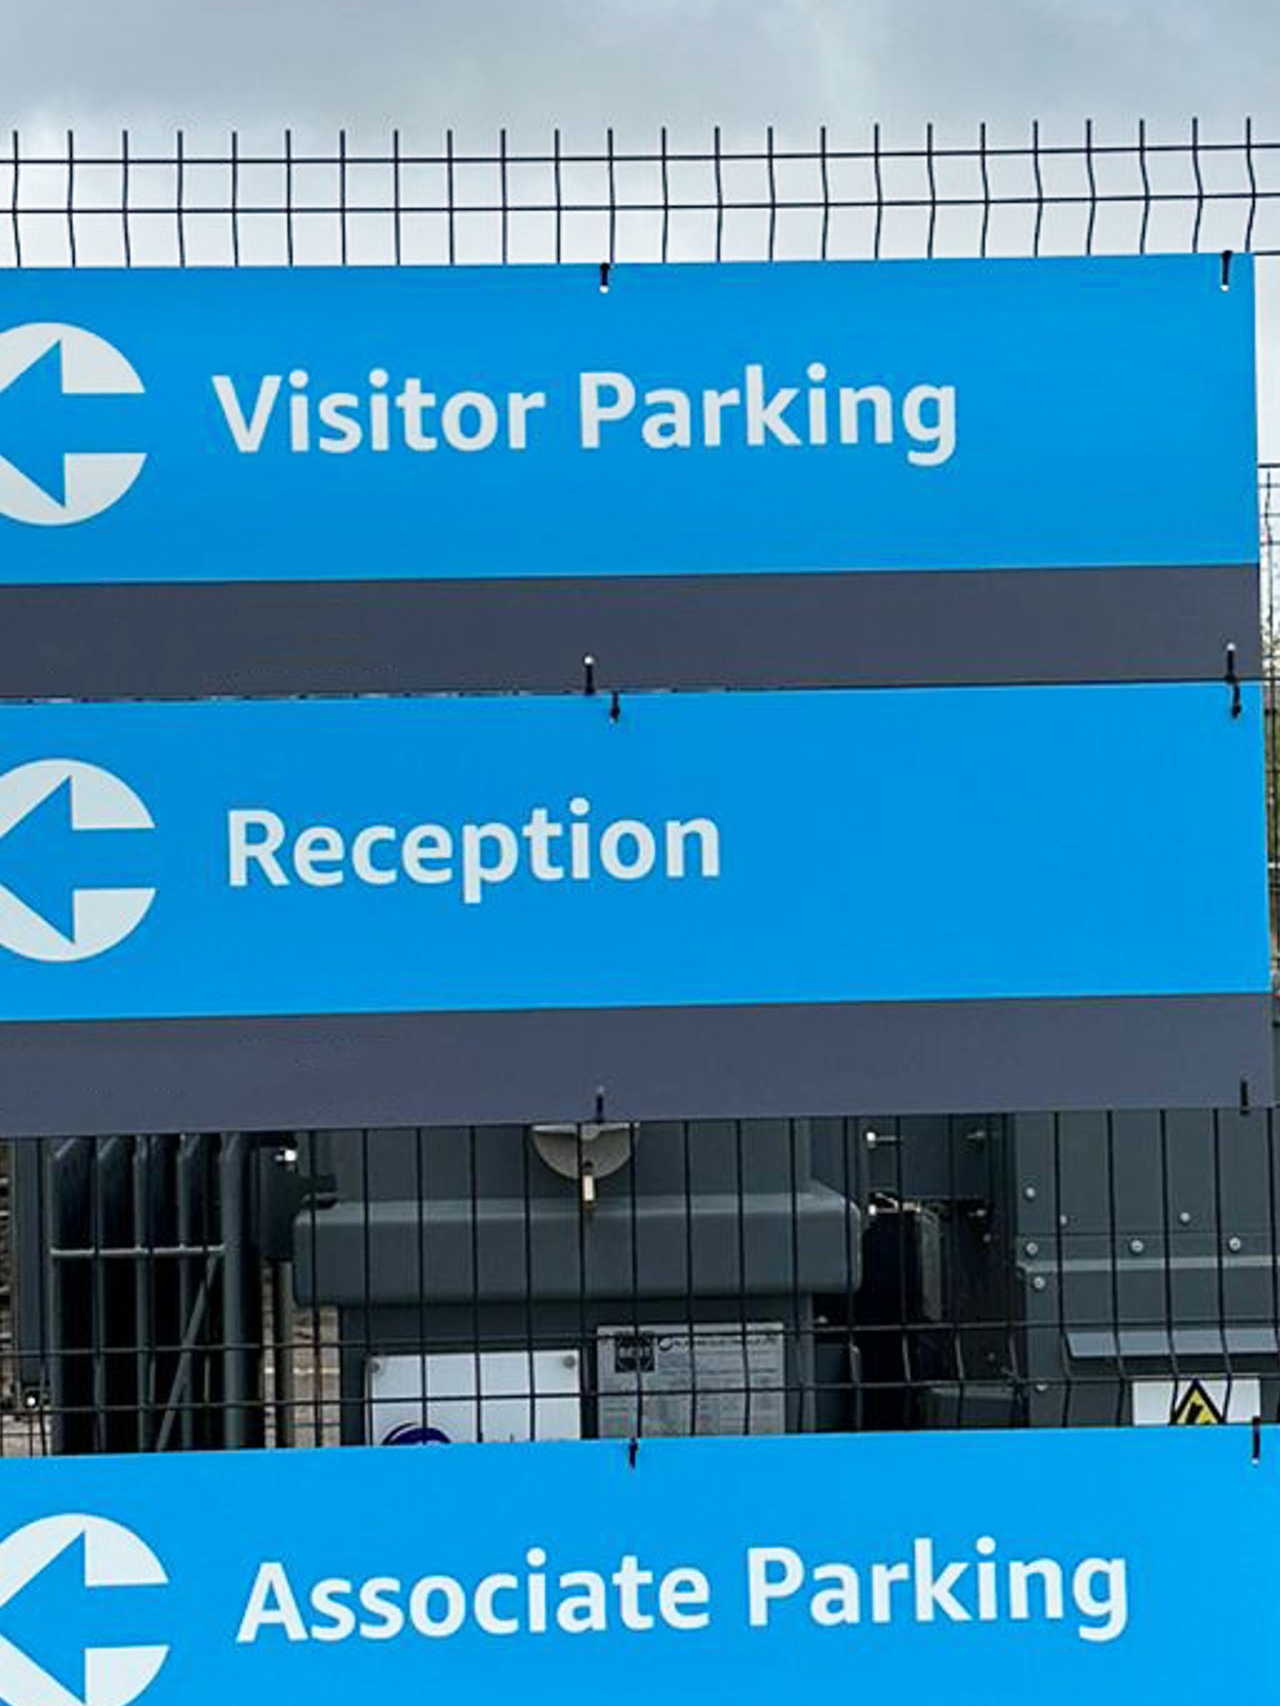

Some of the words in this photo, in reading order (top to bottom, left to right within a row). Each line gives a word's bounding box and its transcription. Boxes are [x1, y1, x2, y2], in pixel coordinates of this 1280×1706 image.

[213, 370, 546, 453] Visitor
[580, 362, 956, 466] Parking
[229, 798, 719, 904] Reception
[237, 1548, 710, 1642] Associate
[748, 1536, 1127, 1642] Parking
